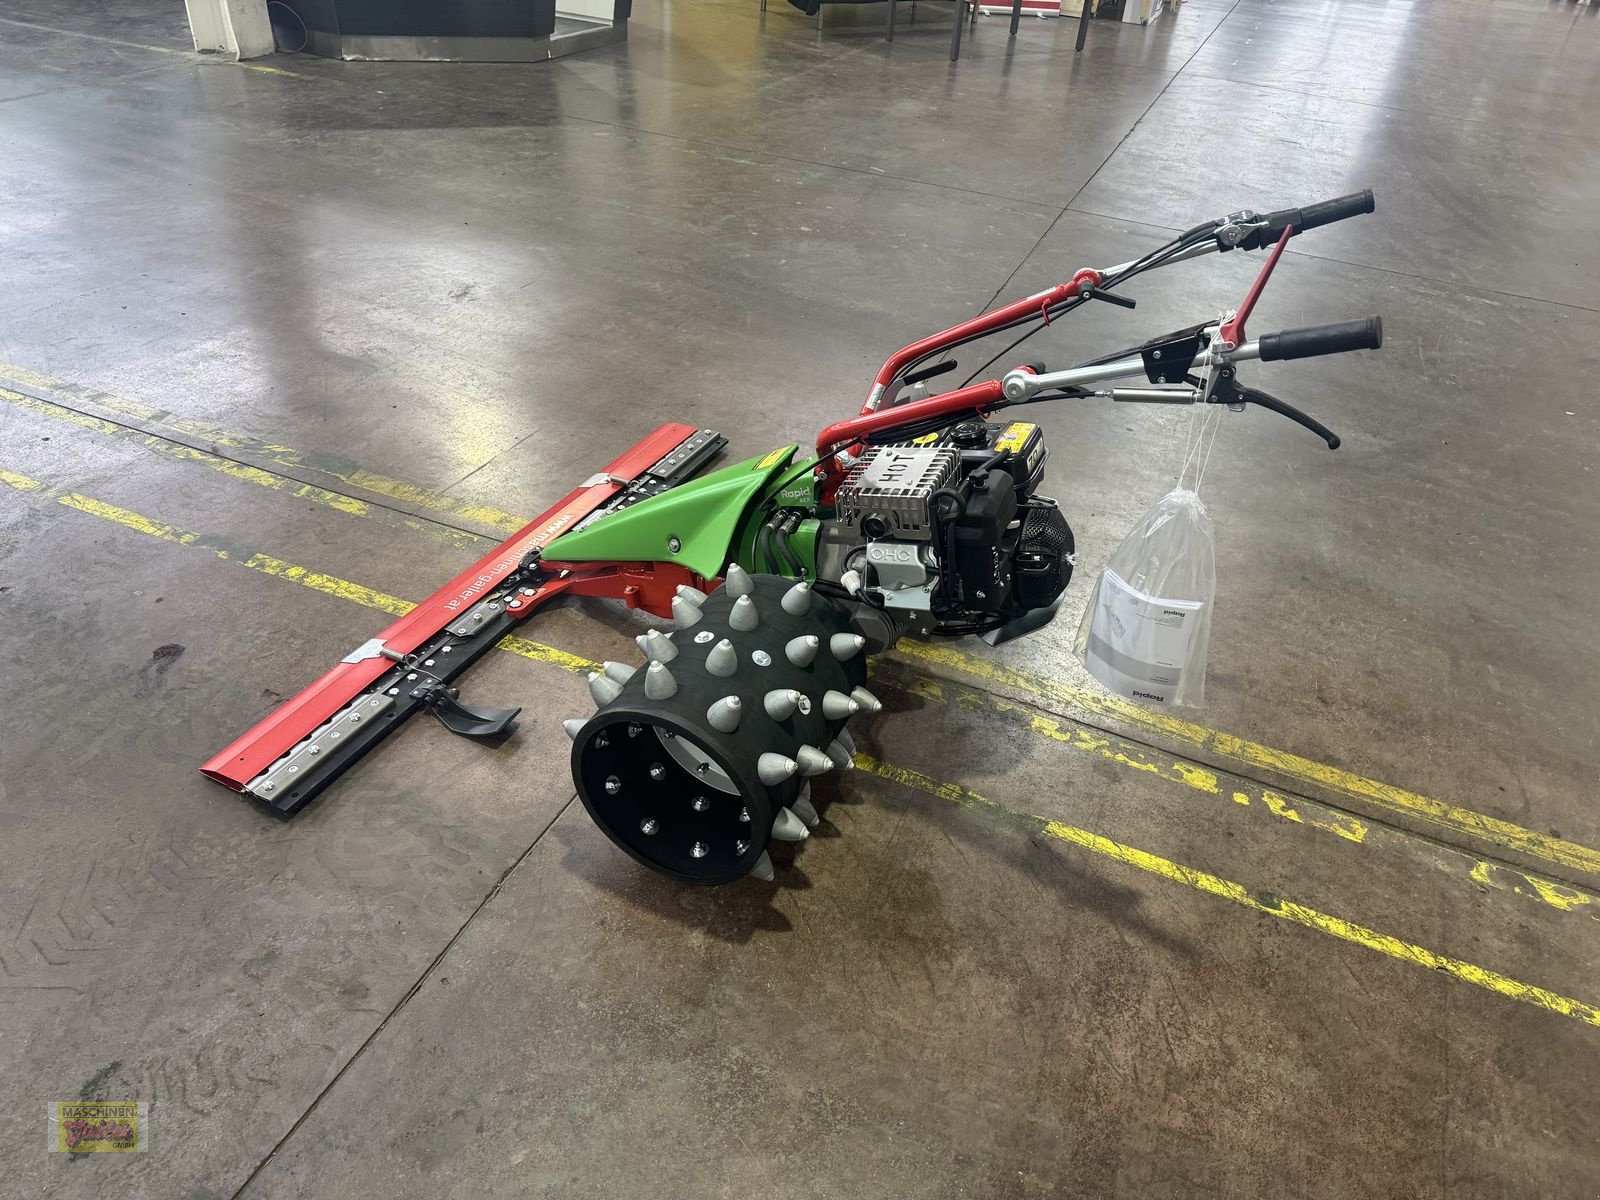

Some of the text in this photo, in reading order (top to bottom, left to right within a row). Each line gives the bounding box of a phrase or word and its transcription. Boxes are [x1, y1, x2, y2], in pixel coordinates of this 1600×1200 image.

[878, 454, 916, 483] HOT
[780, 486, 811, 499] Rapid
[869, 548, 912, 563] OHC
[1163, 609, 1186, 618] Rapid
[1132, 690, 1164, 702] Rapid
